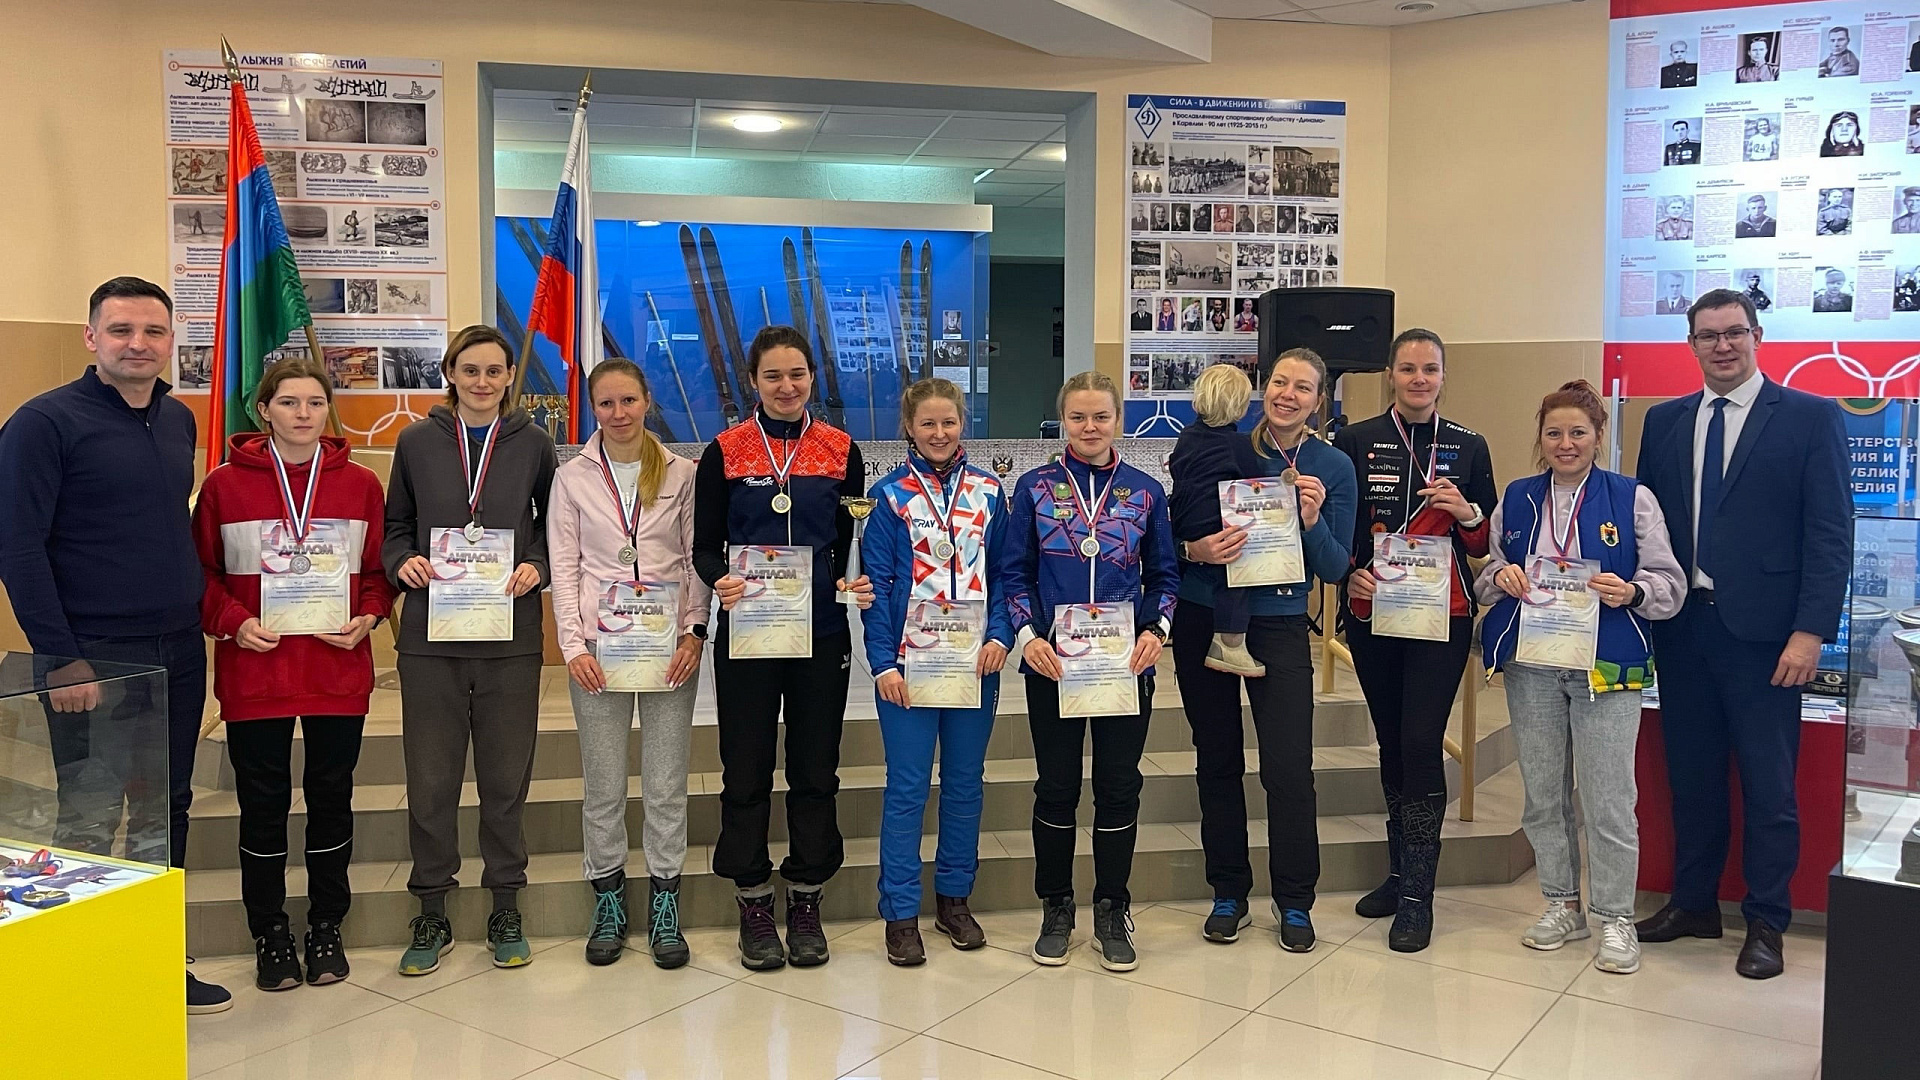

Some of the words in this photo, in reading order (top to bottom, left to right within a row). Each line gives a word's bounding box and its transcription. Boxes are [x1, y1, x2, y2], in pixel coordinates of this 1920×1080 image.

[241, 55, 283, 66] ЛЫЖНЯ
[289, 56, 367, 70] ТЫСЯЧЕЛЕТИЙ
[1169, 98, 1193, 107] СИЛА
[1205, 100, 1250, 109] ДВИЖЕНИИ
[1251, 101, 1257, 109] И
[1172, 112, 1225, 121] Прославленному
[1226, 114, 1265, 123] спортивному
[1445, 422, 1477, 436] TRIMTEX
[1883, 452, 1894, 463] И
[1370, 485, 1396, 493] ABLOY
[1235, 500, 1284, 514] ДИПЛОМ
[1376, 508, 1392, 516] PKS
[278, 544, 334, 556] ДИПЛОМ
[446, 552, 499, 563] ДИПЛОМ
[1388, 556, 1437, 568] ДИПЛОМ
[745, 569, 797, 580] ДИПЛОМ
[1538, 579, 1586, 592] ДИПЛОМ
[613, 605, 664, 616] ДИПЛОМ
[921, 621, 969, 632] ДИПЛОМ
[1071, 626, 1120, 640] ДИПЛОМ
